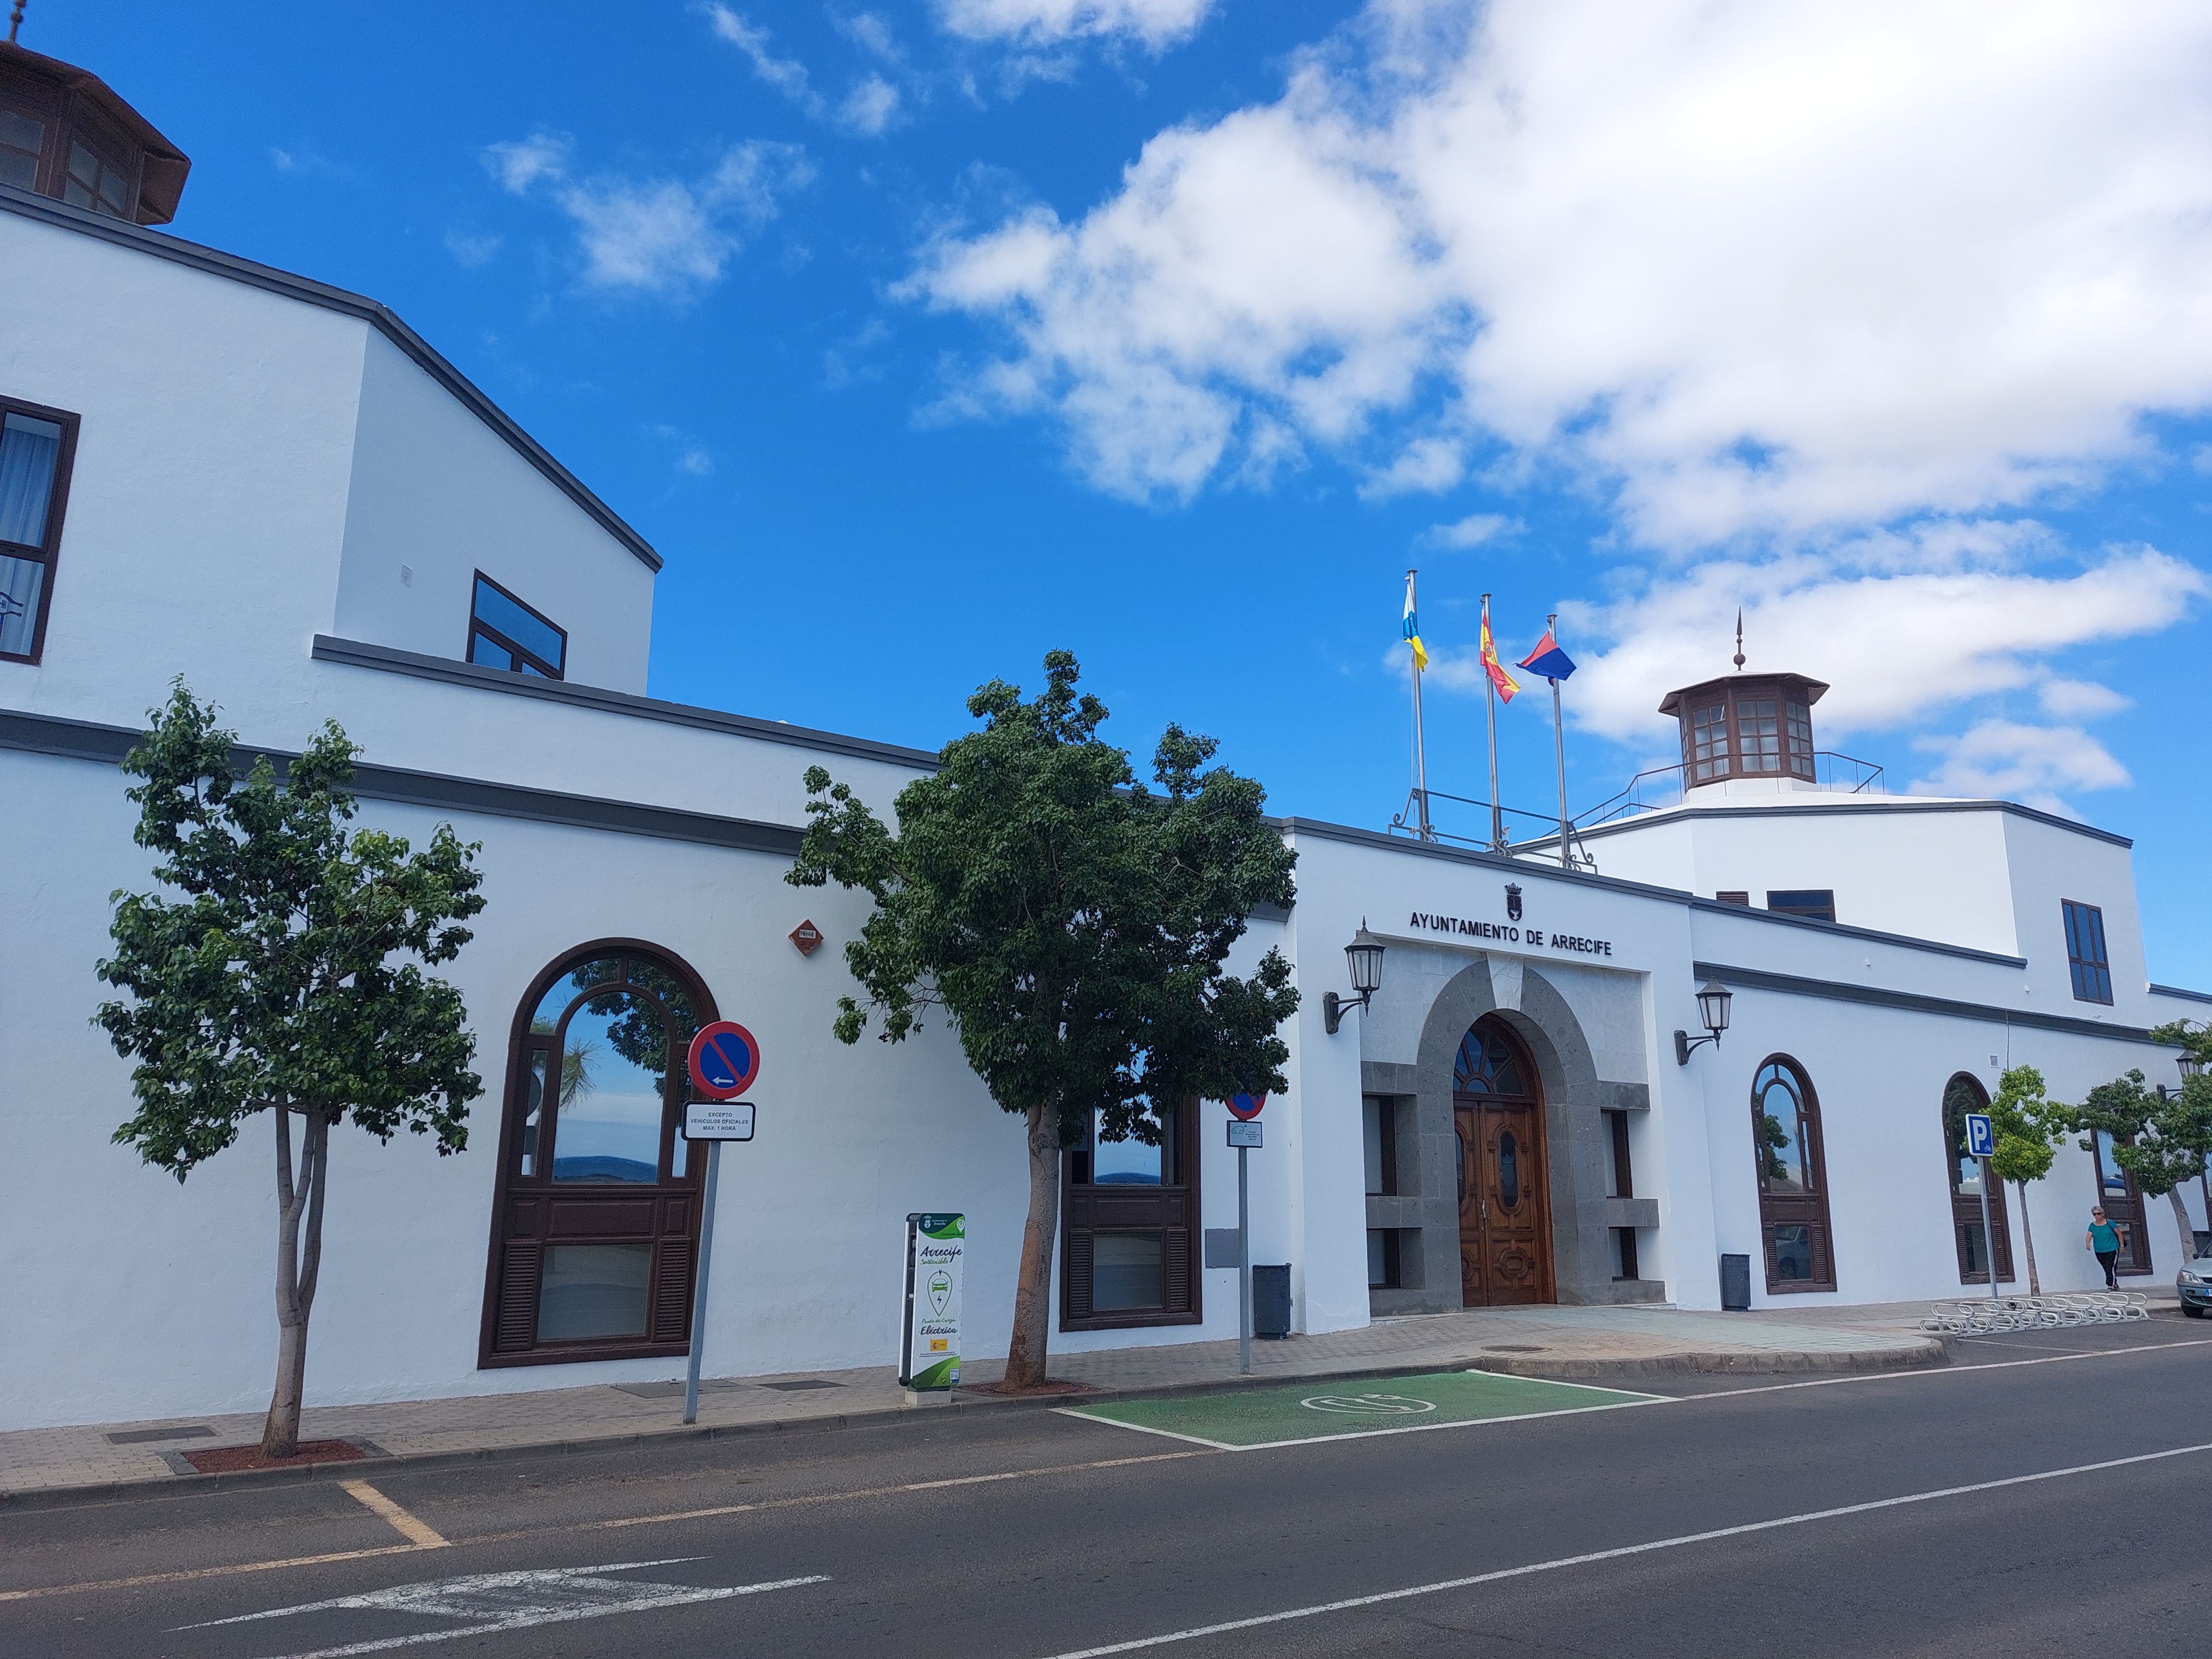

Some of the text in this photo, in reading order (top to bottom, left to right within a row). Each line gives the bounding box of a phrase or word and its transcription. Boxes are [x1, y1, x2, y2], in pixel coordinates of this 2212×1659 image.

[1409, 911, 1613, 956] AYUNTAMIENTO DE ARRECIFE
[1972, 1119, 1987, 1150] P
[920, 1244, 963, 1263] Arrecife
[920, 1325, 958, 1335] Eléctrica
